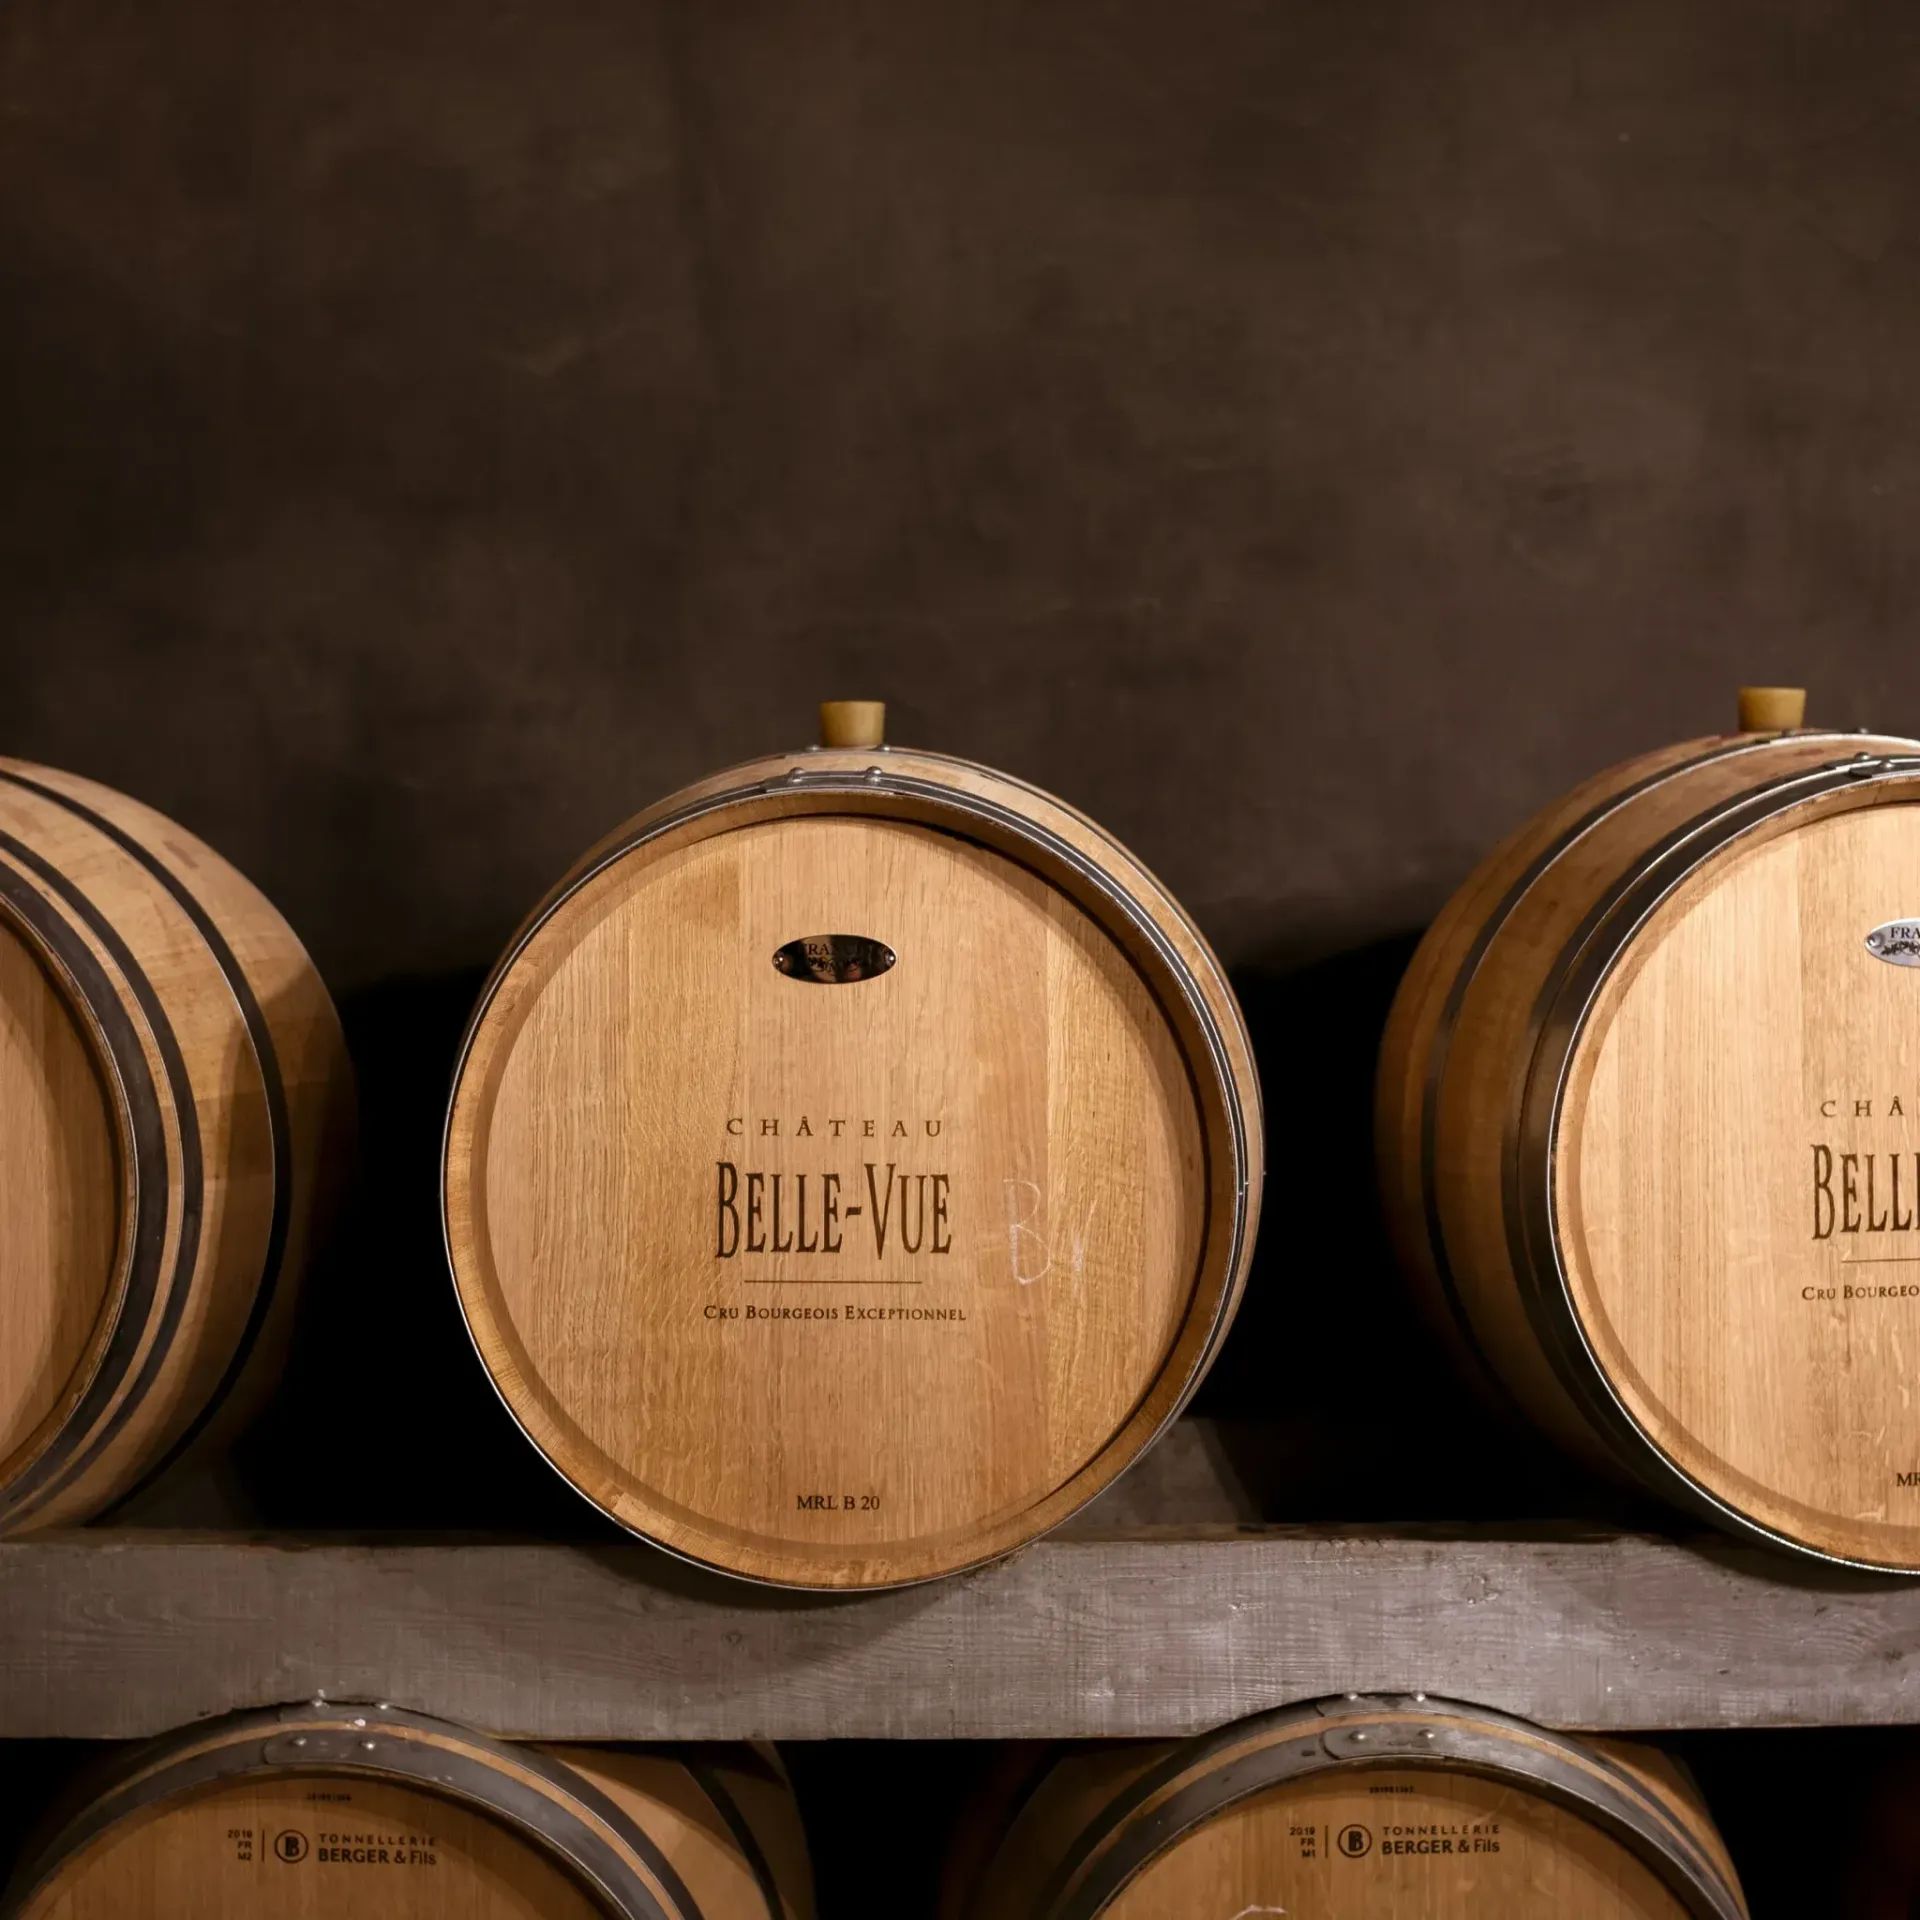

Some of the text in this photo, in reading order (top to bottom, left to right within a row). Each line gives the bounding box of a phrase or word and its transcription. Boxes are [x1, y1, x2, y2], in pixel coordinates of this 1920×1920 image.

[727, 1116, 943, 1137] CHÂTEAU
[715, 1161, 952, 1260] BELLE-VUE
[704, 1305, 967, 1321] CRU BOURGEOIS EXCEPTIONNEL
[796, 1495, 880, 1510] MRL B 20
[1383, 1824, 1500, 1836] TONNELLERIE
[319, 1833, 437, 1847] TONNELLERIE
[1382, 1839, 1452, 1855] BERGER
[318, 1849, 389, 1863] BERGER
